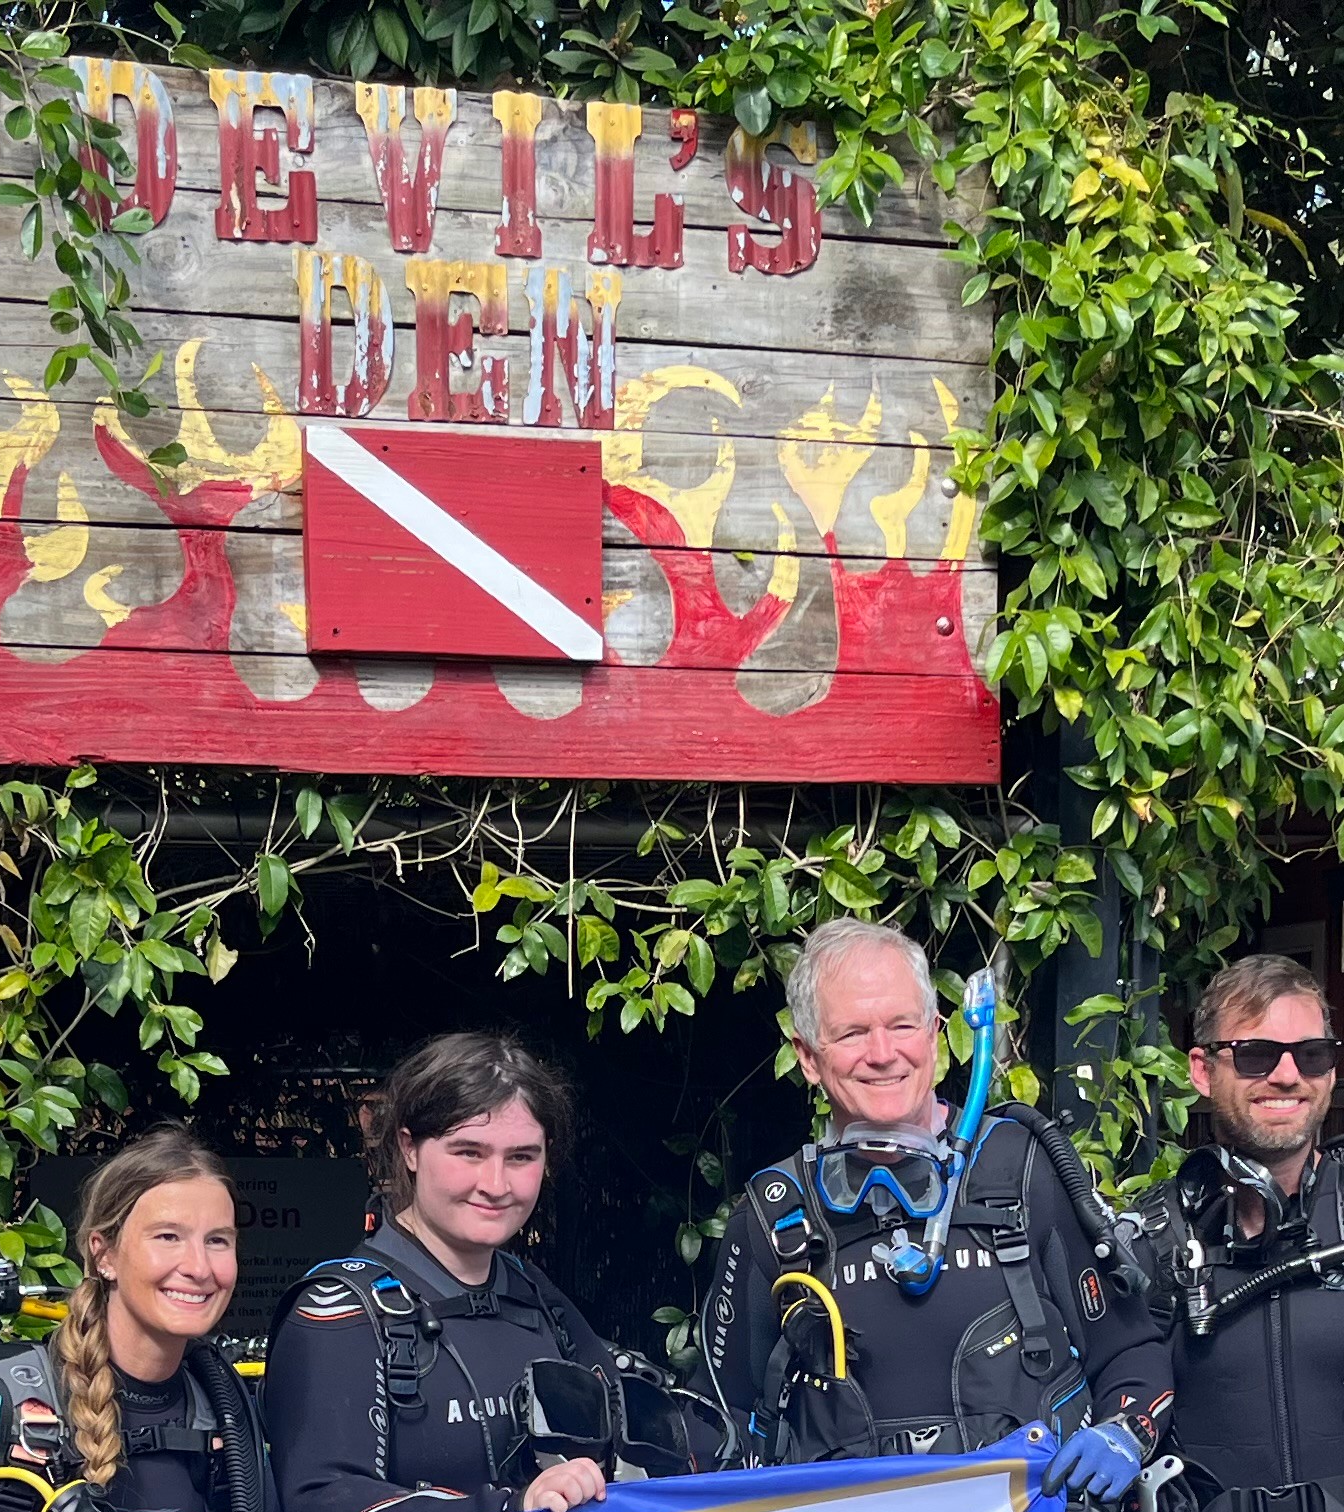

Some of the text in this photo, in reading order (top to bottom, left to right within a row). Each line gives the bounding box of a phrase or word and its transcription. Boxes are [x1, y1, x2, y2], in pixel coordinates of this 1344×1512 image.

[68, 56, 822, 275] DEVIL'S
[291, 249, 622, 428] DEN
[235, 1201, 301, 1228] Den
[832, 1261, 877, 1290] UA
[712, 1243, 741, 1369] AQUA LUNG
